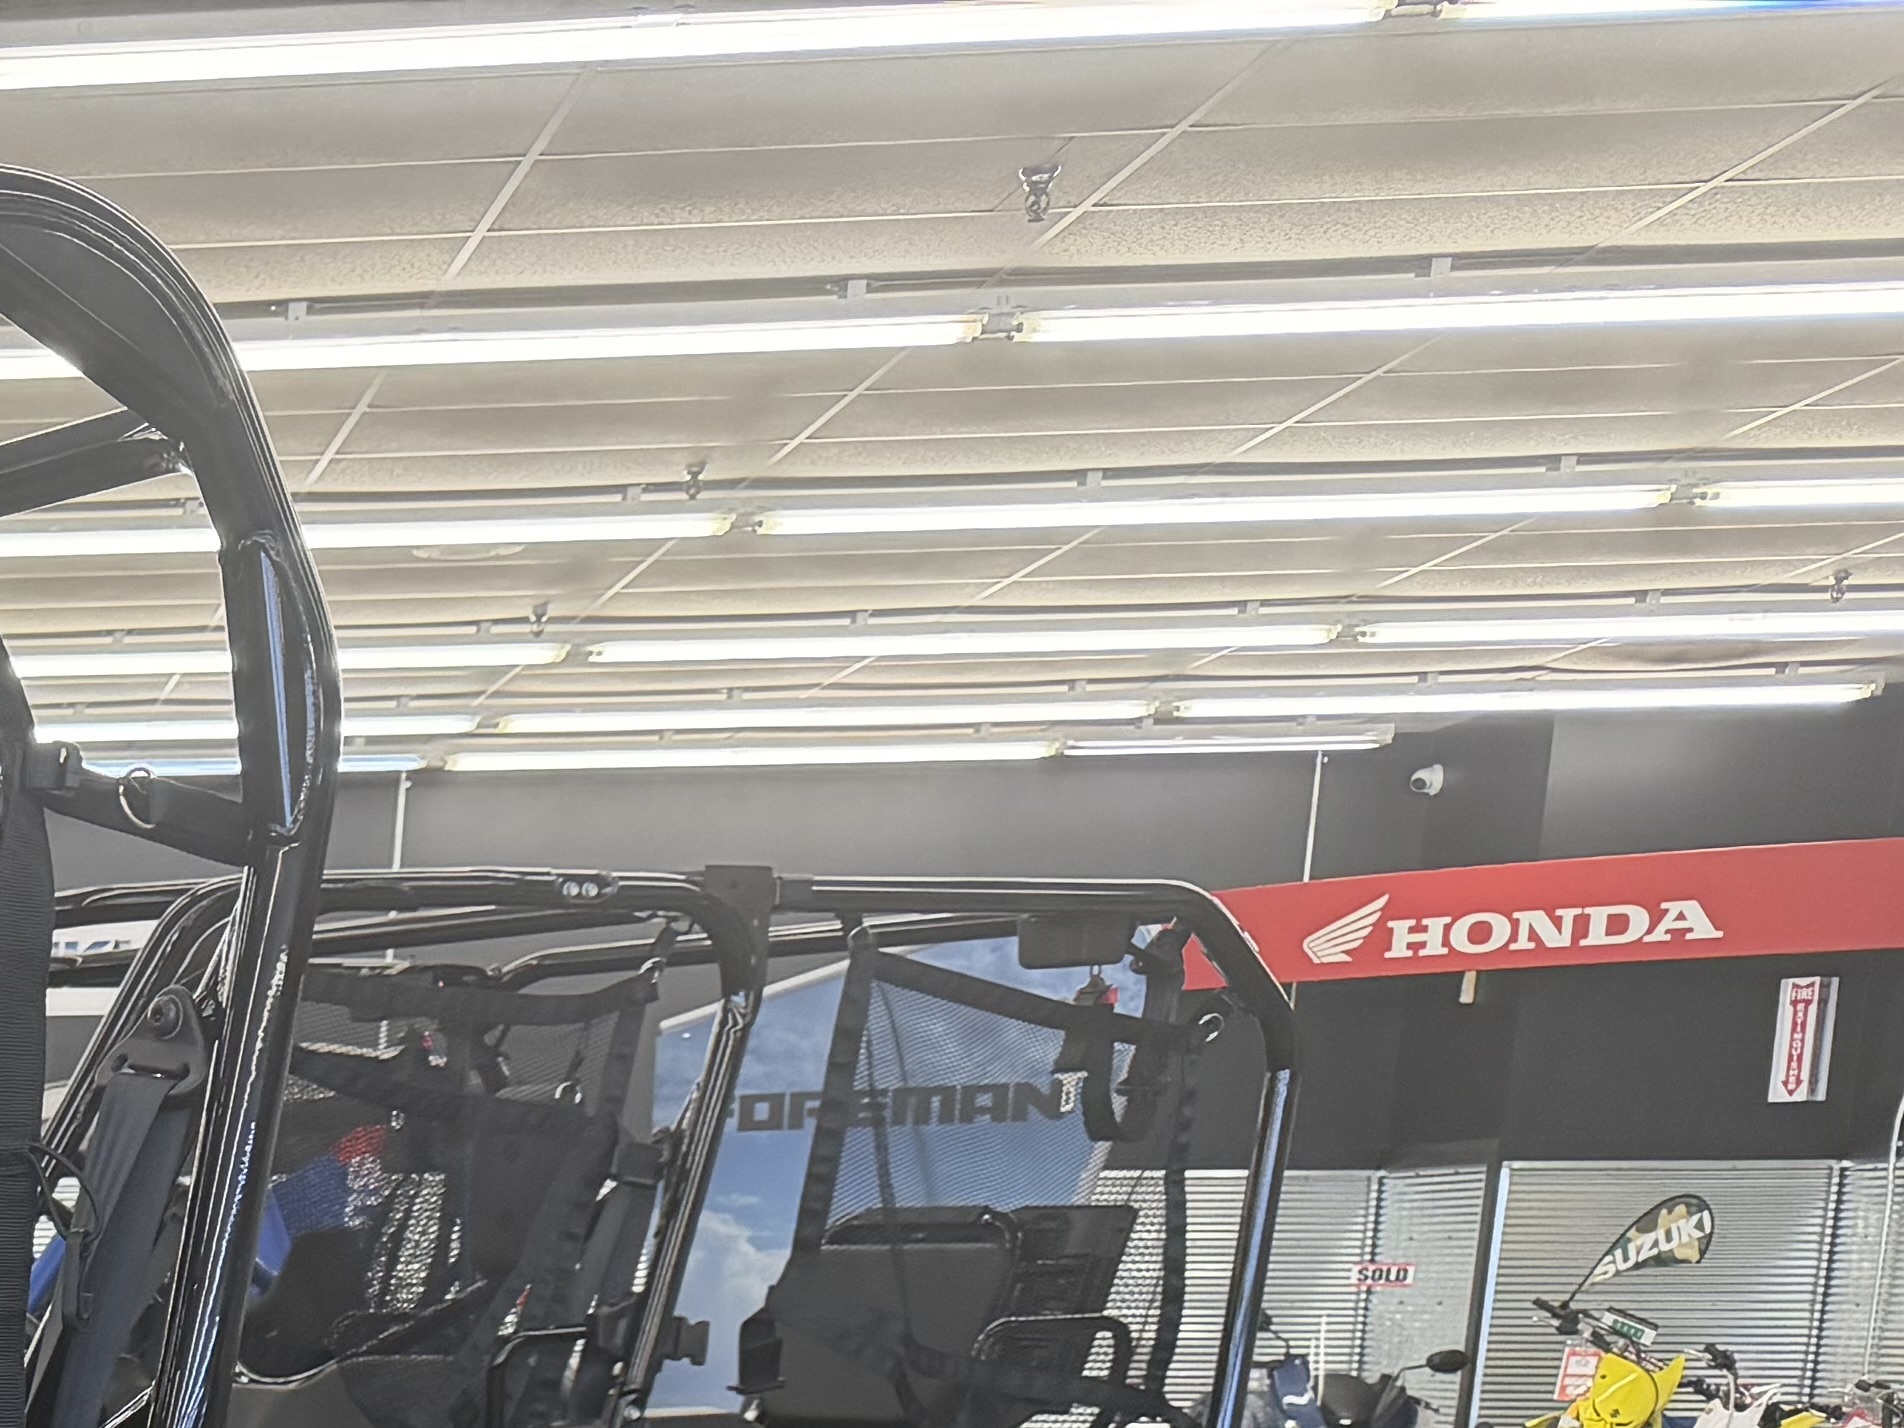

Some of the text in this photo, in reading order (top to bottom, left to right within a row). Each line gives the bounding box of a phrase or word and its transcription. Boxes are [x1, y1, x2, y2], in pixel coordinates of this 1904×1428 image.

[1384, 899, 1724, 958] HONDA
[1792, 986, 1814, 1001] FIRE
[1589, 1209, 1712, 1285] SUZUKI
[1357, 1266, 1409, 1283] SOLD
